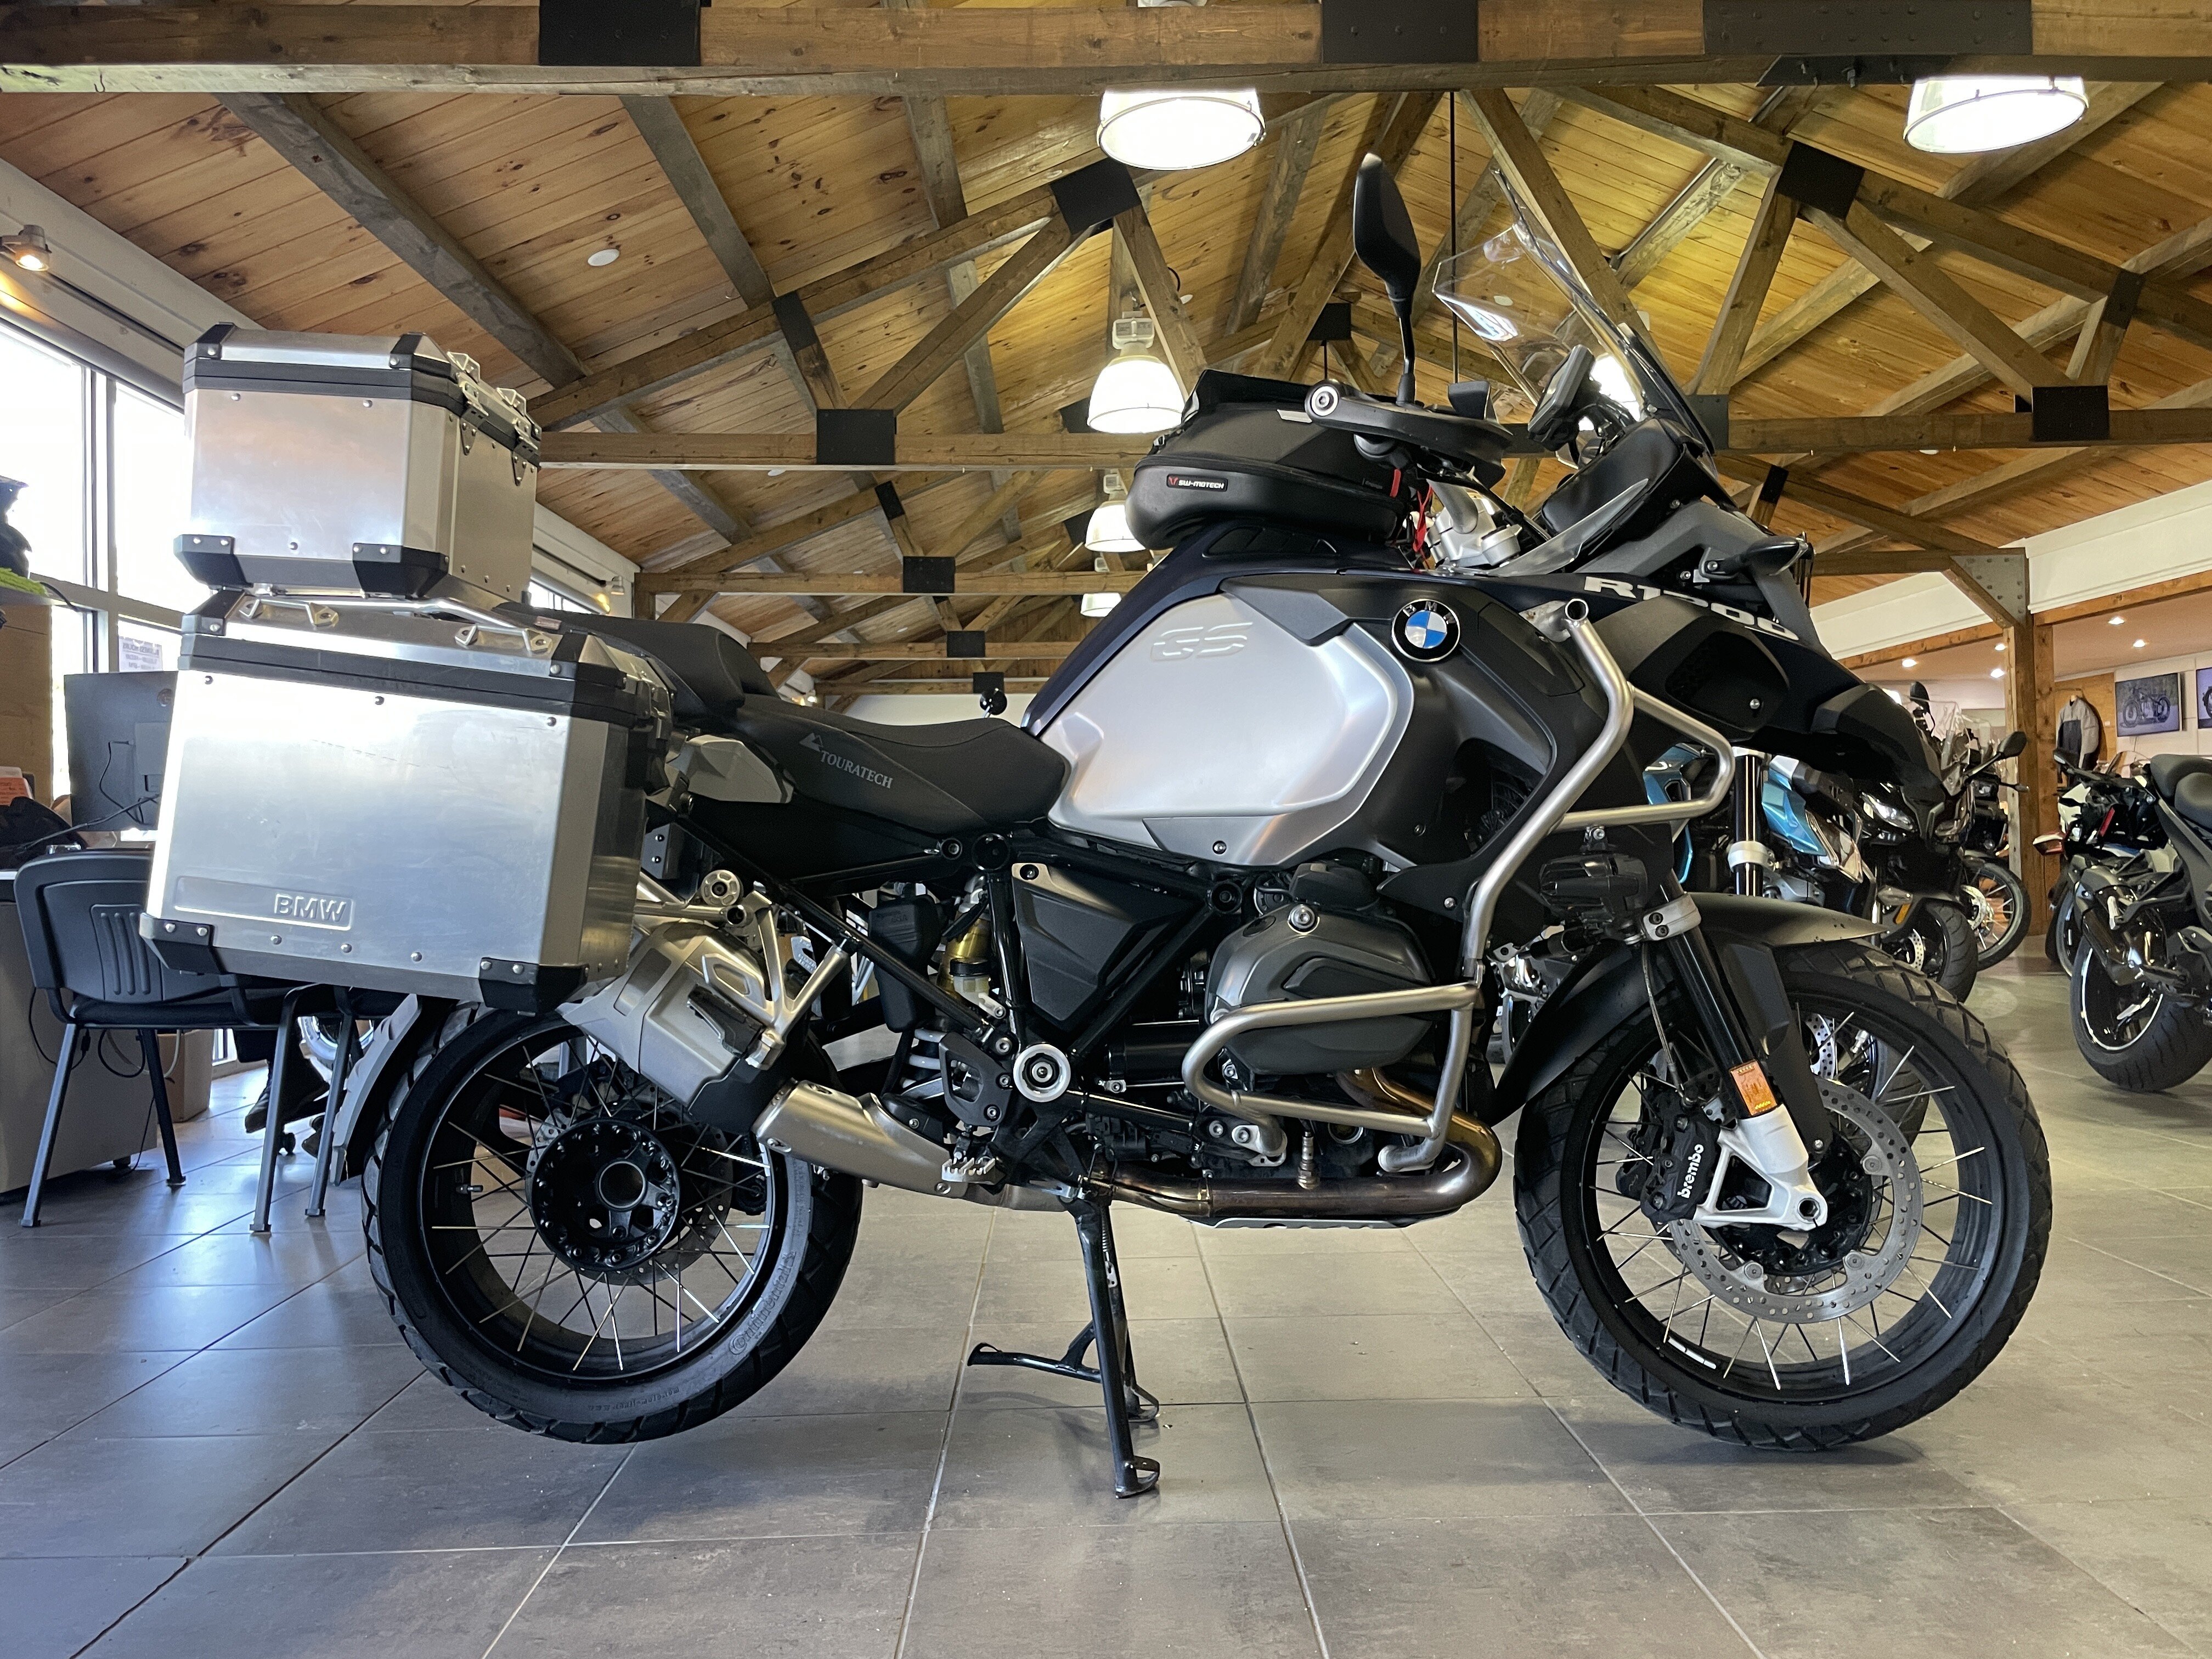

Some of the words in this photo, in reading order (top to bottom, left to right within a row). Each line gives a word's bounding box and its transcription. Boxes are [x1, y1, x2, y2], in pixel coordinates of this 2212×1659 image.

[1178, 479, 1224, 489] SW-MOTECH
[1402, 601, 1457, 625] BMW
[1150, 622, 1253, 662] GS
[821, 750, 894, 789] TOURATECH
[274, 894, 347, 922] BMW
[1677, 1144, 1704, 1199] brembo
[729, 1266, 792, 1355] Continental
